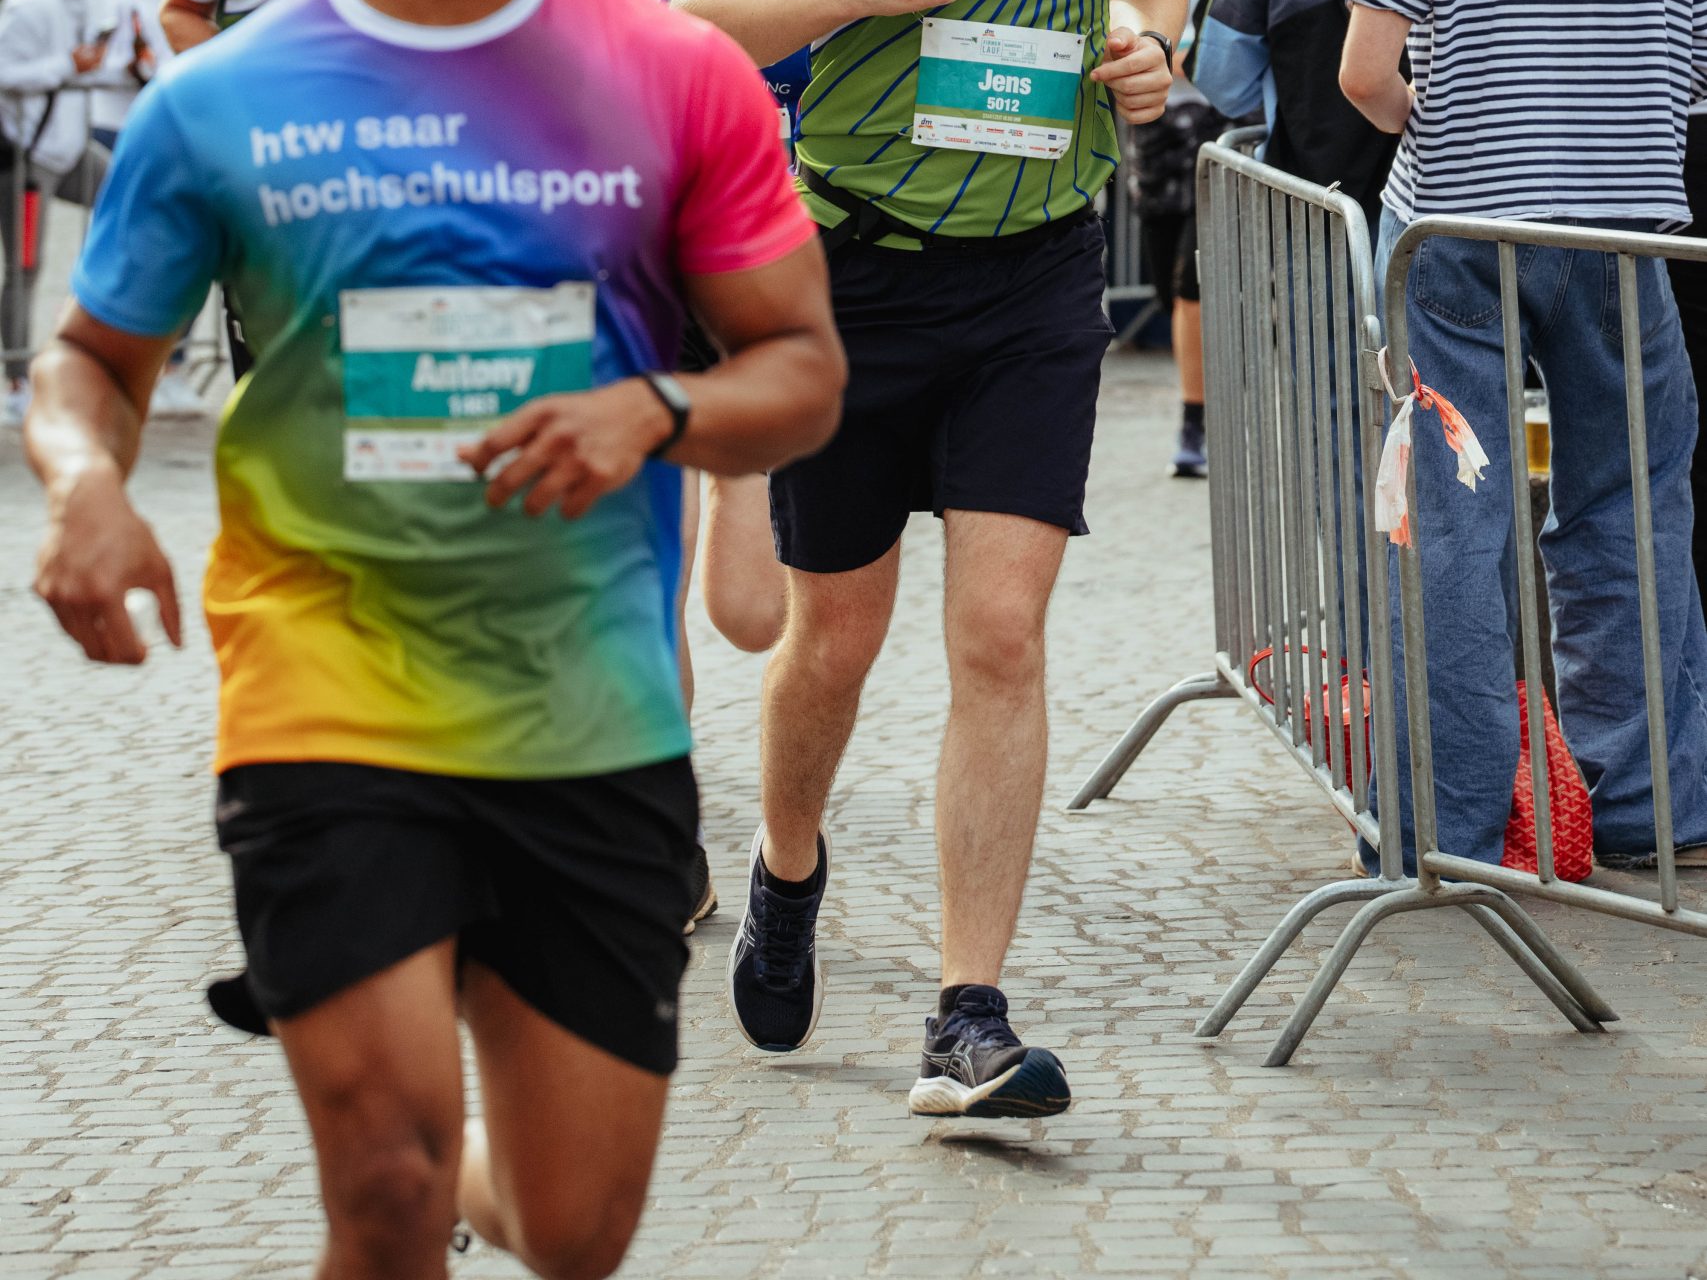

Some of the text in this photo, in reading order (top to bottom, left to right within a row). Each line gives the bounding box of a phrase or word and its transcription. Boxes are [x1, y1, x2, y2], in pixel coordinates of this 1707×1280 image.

[982, 46, 1001, 55] LAUF
[978, 68, 1032, 95] Jens
[986, 96, 1020, 113] 5012
[250, 111, 467, 167] htw saar
[258, 160, 643, 227] hochschulsport
[411, 353, 535, 396] Antony
